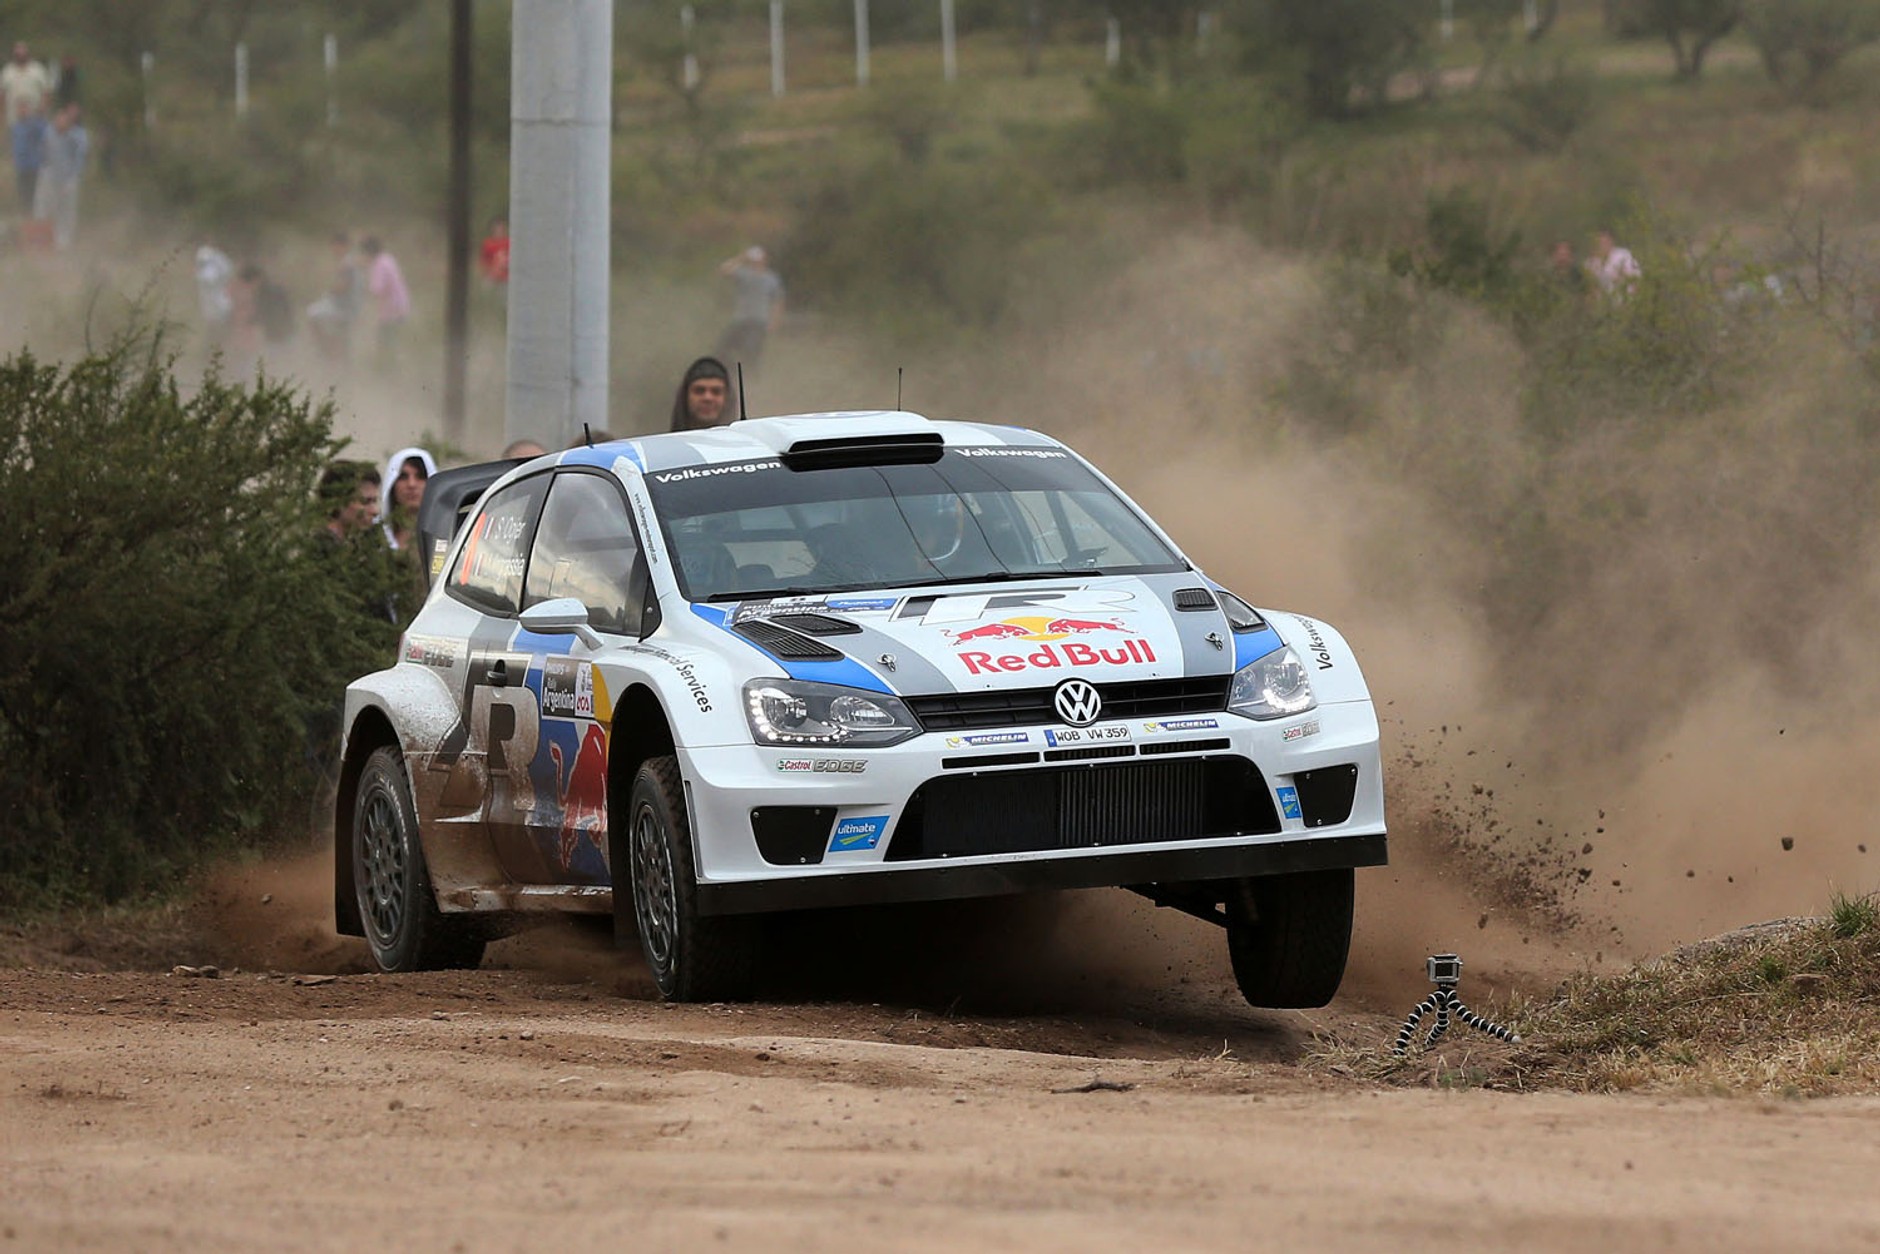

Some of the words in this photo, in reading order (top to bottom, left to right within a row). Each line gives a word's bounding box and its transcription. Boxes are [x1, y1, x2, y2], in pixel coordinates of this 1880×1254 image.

[955, 448, 1067, 459] Volkswagen
[655, 461, 781, 483] Volkswagen
[957, 644, 1061, 674] Red
[1061, 639, 1157, 666] Bull
[676, 662, 712, 713] Services
[543, 687, 574, 712] Argentina
[1166, 720, 1216, 729] MICHELIN
[971, 733, 1027, 744] MICHELIN
[1055, 731, 1080, 742] WOB
[1087, 729, 1104, 739] VW
[1106, 727, 1128, 738] 359
[785, 760, 812, 770] Castrol
[813, 760, 868, 773] EDGE
[837, 823, 876, 835] ultimate
